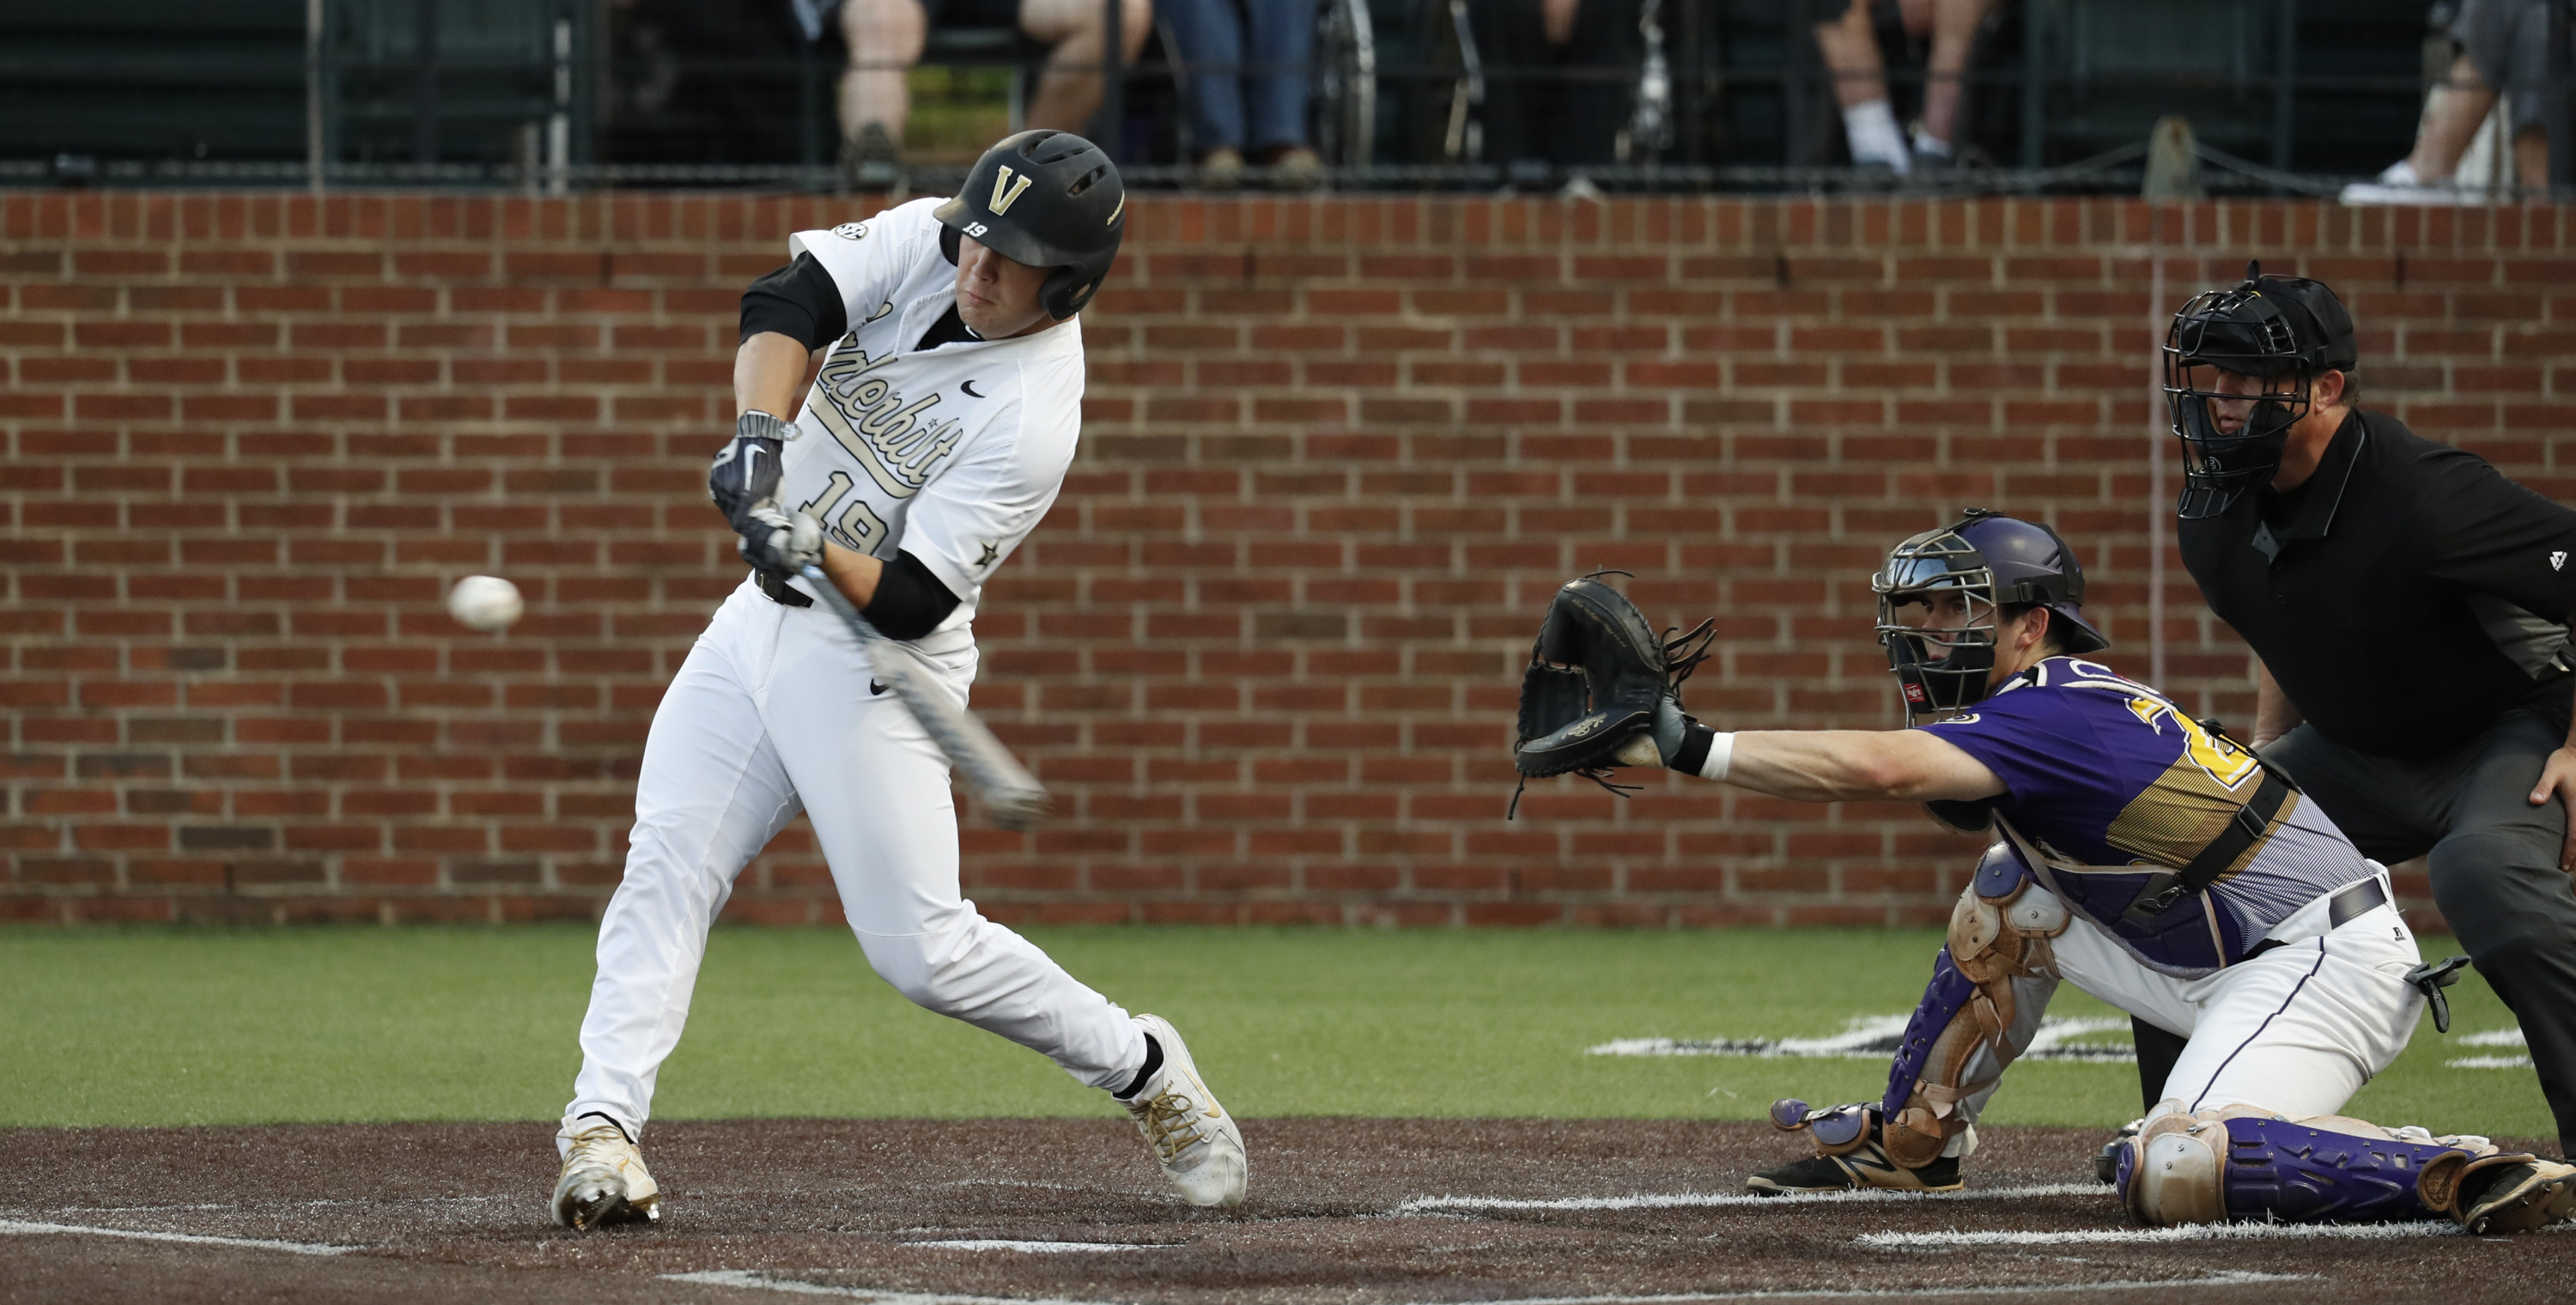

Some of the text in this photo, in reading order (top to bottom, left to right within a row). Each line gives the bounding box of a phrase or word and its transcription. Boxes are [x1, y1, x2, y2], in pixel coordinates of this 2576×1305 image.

[988, 165, 1032, 216] V
[962, 222, 988, 238] 19
[817, 301, 963, 487] nderbilt
[799, 470, 890, 556] 19
